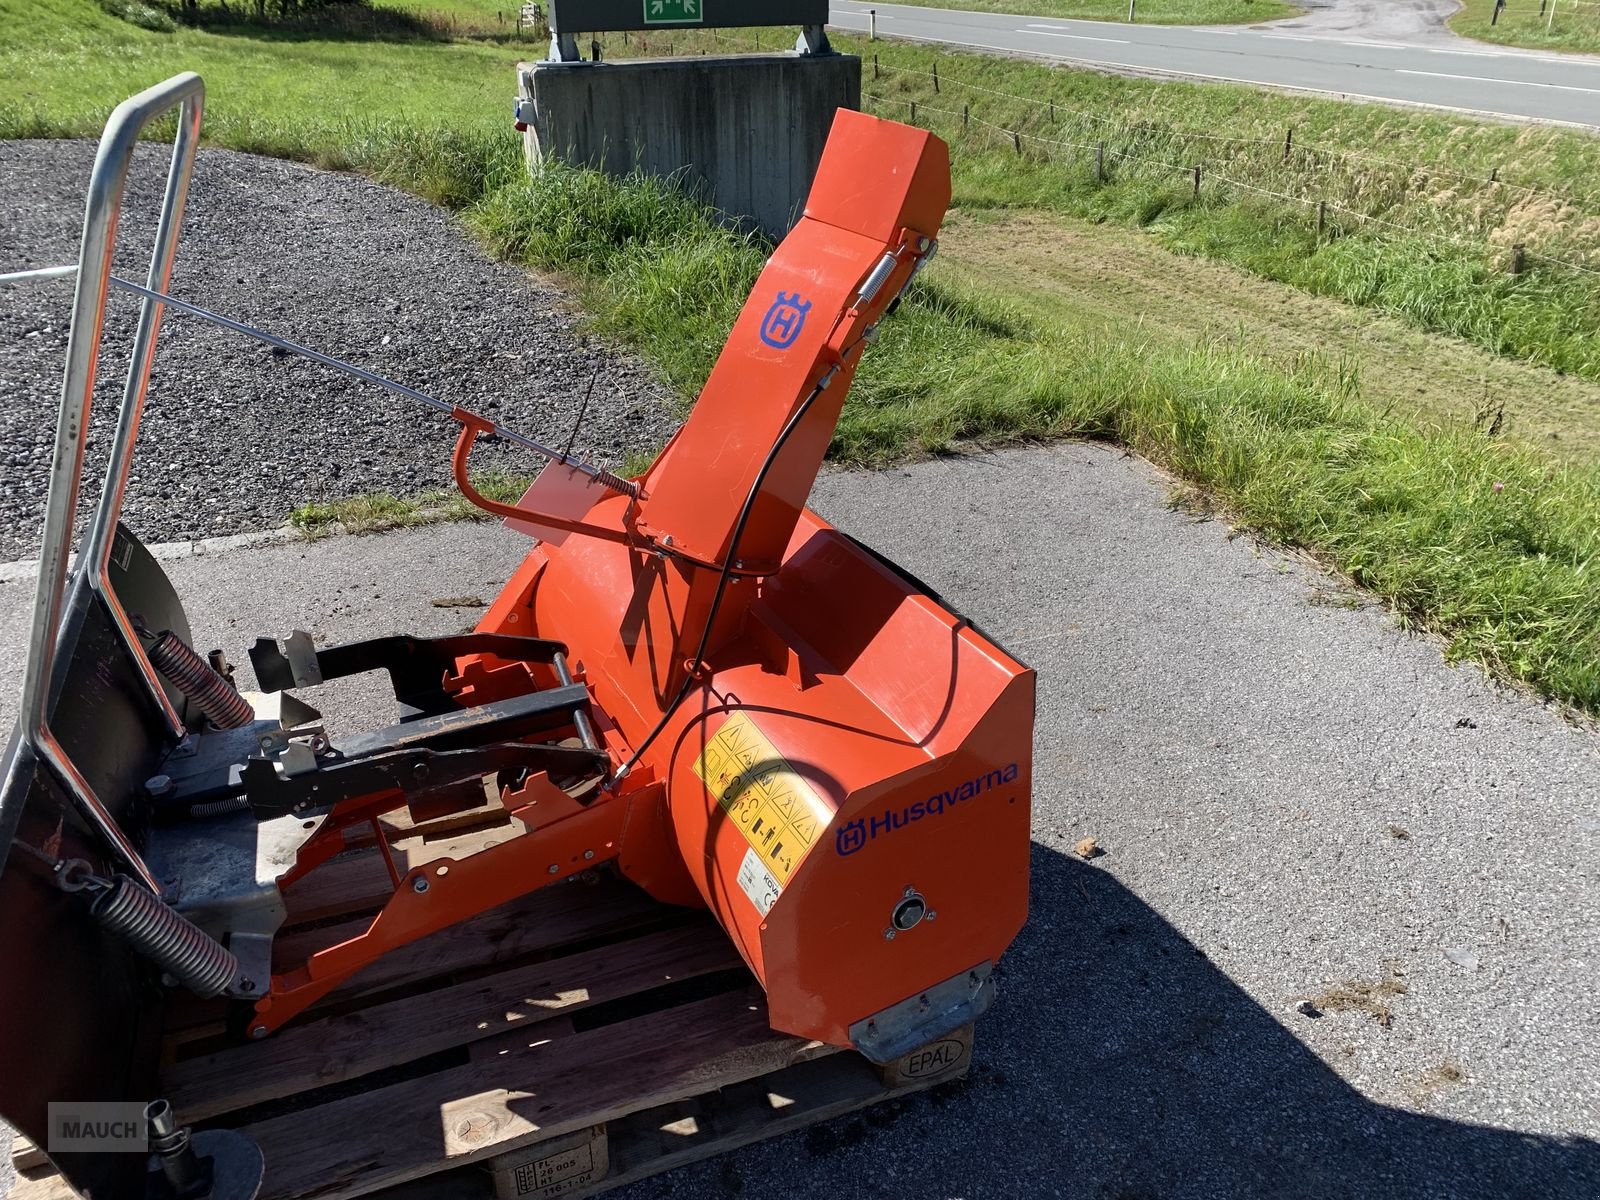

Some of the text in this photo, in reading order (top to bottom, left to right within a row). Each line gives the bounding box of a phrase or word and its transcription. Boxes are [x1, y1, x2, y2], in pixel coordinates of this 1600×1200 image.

[870, 763, 1018, 839] Husqvarna
[909, 1045, 953, 1074] EPAL
[541, 1159, 576, 1177] 26 005
[543, 1173, 592, 1196] 116-1-04
